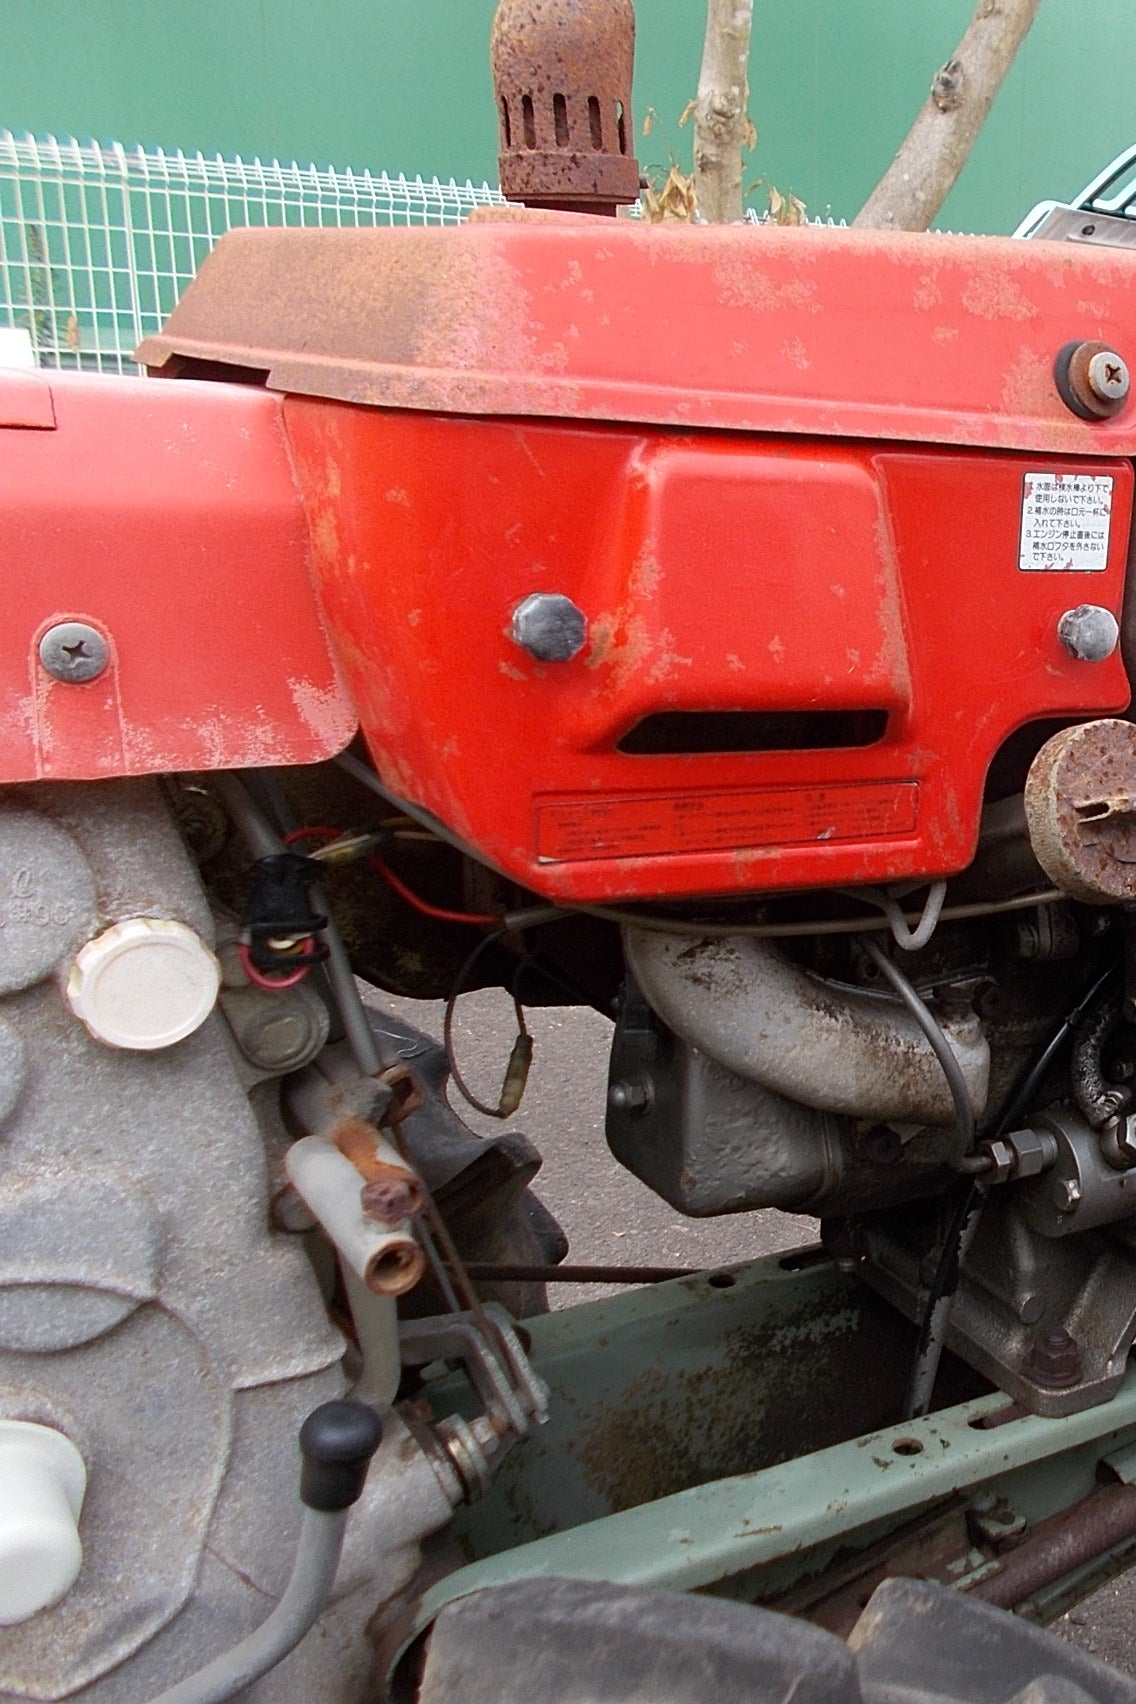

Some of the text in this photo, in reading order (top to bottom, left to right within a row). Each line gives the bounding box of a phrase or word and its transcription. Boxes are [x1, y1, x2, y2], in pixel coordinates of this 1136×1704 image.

[1035, 493, 1104, 505] 使用しないで下さい。
[1033, 518, 1080, 529] 入れて下さい。
[1032, 552, 1064, 561] で下さい。
